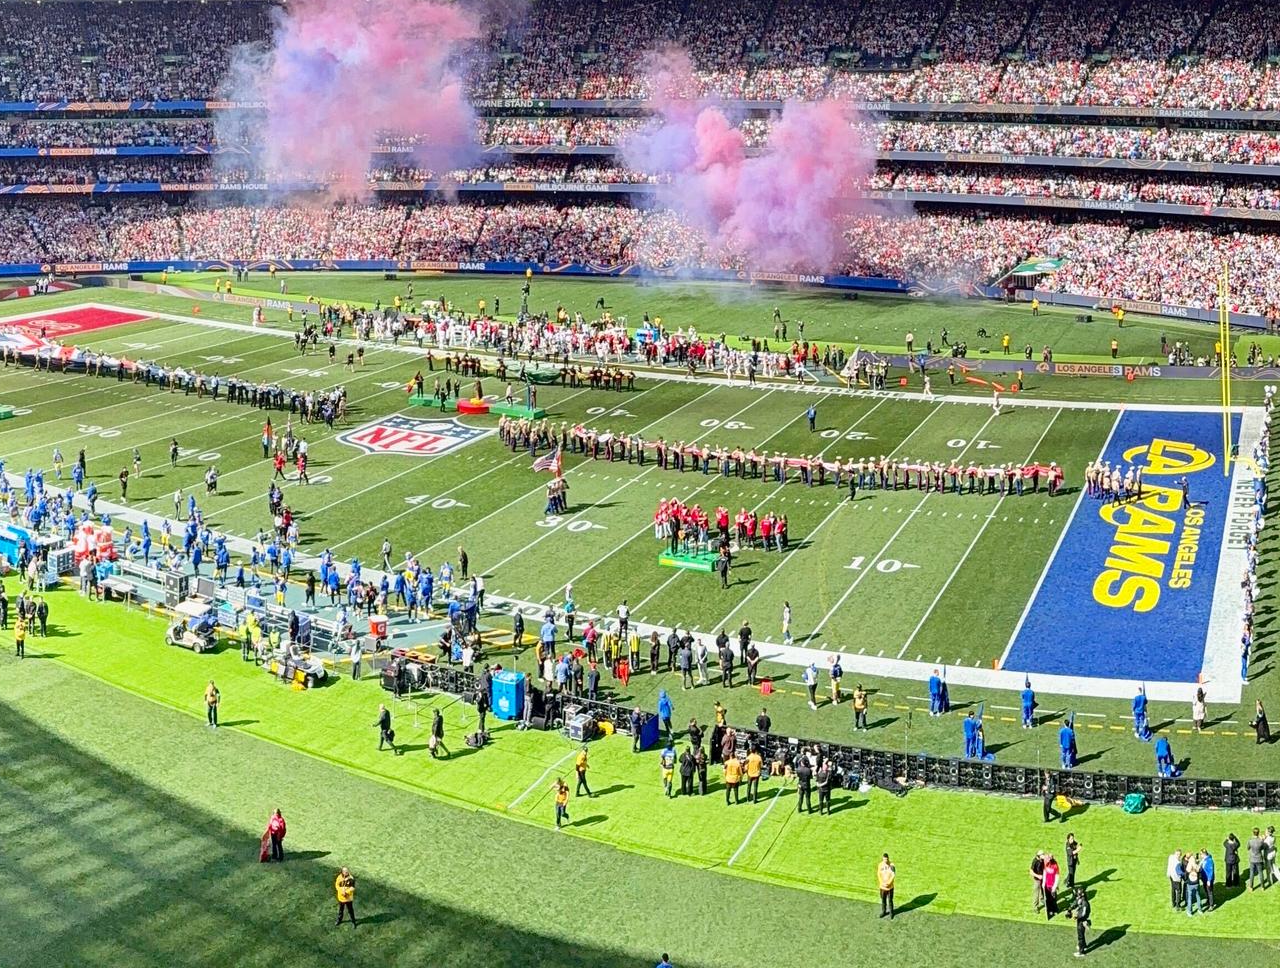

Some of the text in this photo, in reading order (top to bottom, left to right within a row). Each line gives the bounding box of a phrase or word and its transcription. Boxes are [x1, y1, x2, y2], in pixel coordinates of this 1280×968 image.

[867, 102, 890, 110] GAME
[1100, 108, 1208, 118] WHOSE HOUSE? RAMS HOUSE
[535, 183, 584, 191] MELBOURNE
[585, 183, 609, 191] GAME
[1024, 198, 1134, 210] WHOSE HOUSE? RAMS HOUSE
[459, 262, 486, 270] RAMS
[767, 272, 796, 280] ANGELES
[799, 275, 825, 283] RAMS
[267, 299, 292, 309] RAMS
[1127, 302, 1159, 312] ANGELES
[1162, 306, 1187, 316] RAMS
[1057, 364, 1161, 376] LOS ANGELES RAMS
[353, 427, 446, 450] NFL
[1233, 479, 1256, 508] NEVER
[404, 494, 456, 509] 40
[535, 515, 592, 532] 30
[1092, 483, 1184, 613] RAMS
[1168, 503, 1206, 589] LOS ANGELES
[843, 556, 902, 572] 10
